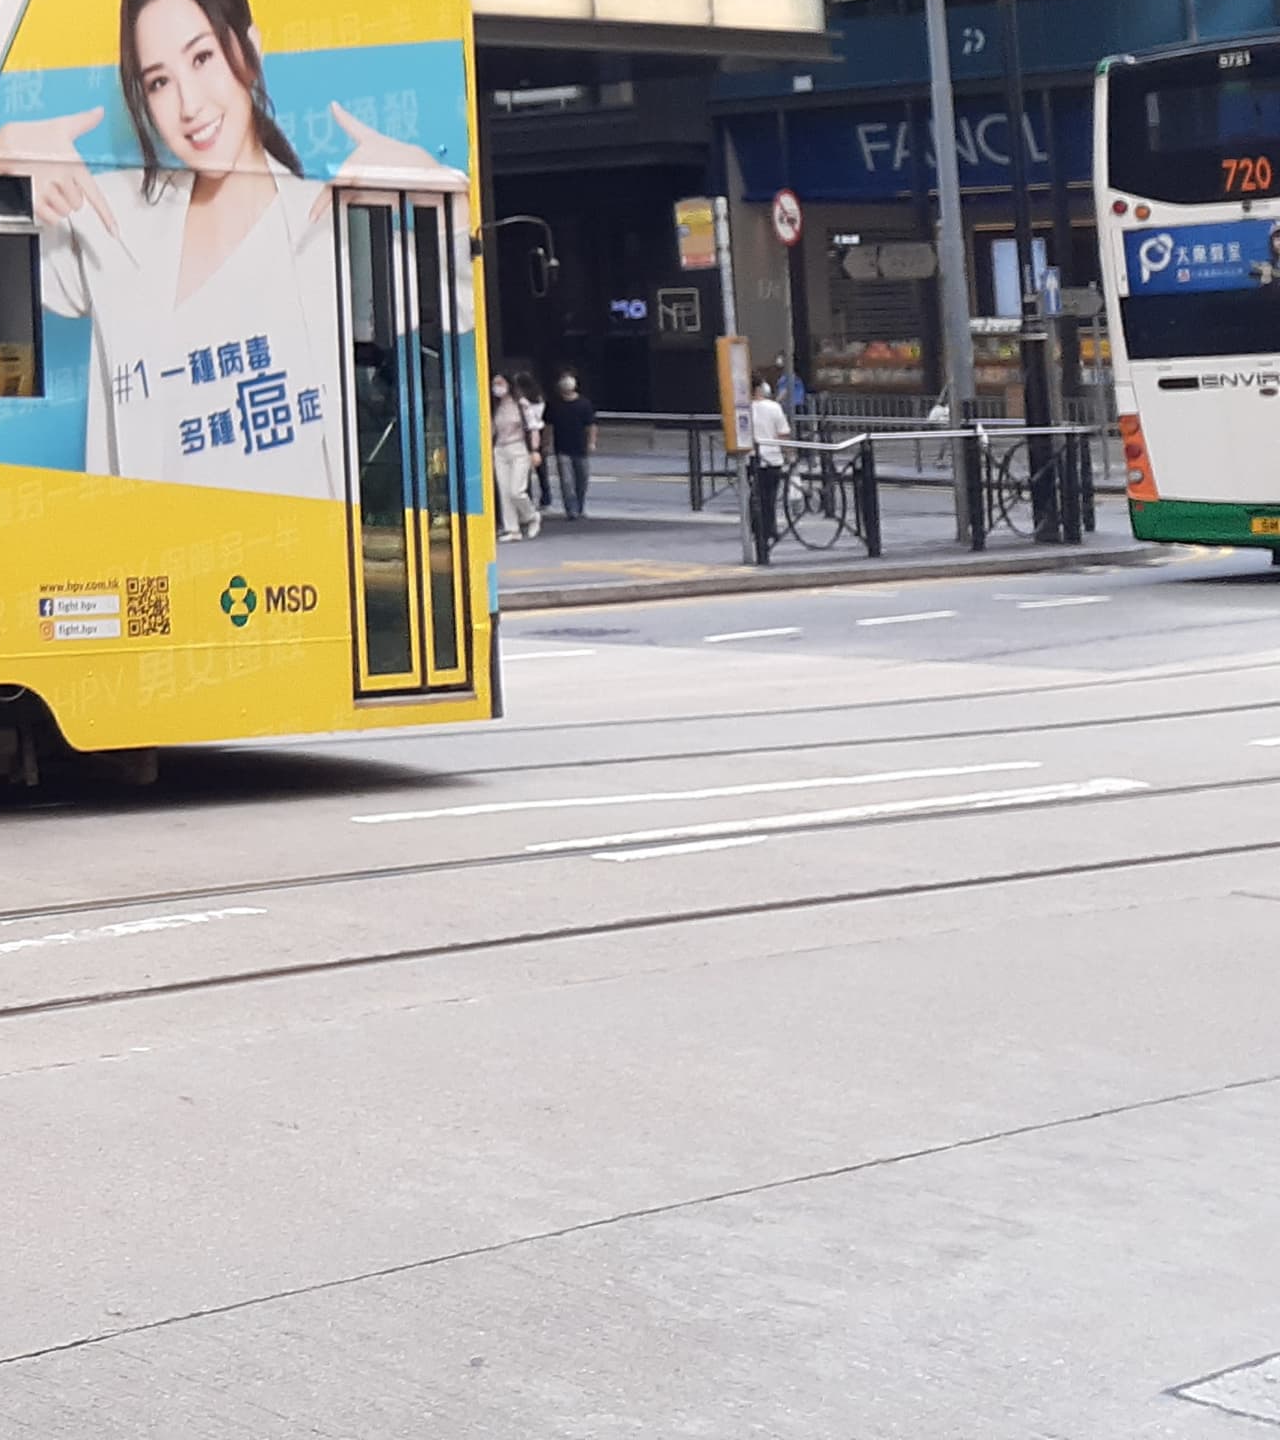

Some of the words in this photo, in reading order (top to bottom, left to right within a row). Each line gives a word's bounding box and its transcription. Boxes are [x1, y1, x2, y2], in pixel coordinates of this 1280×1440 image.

[1221, 155, 1273, 192] 720
[113, 358, 150, 406] #1
[160, 334, 272, 386] 一種病毒
[264, 583, 318, 614] MSD
